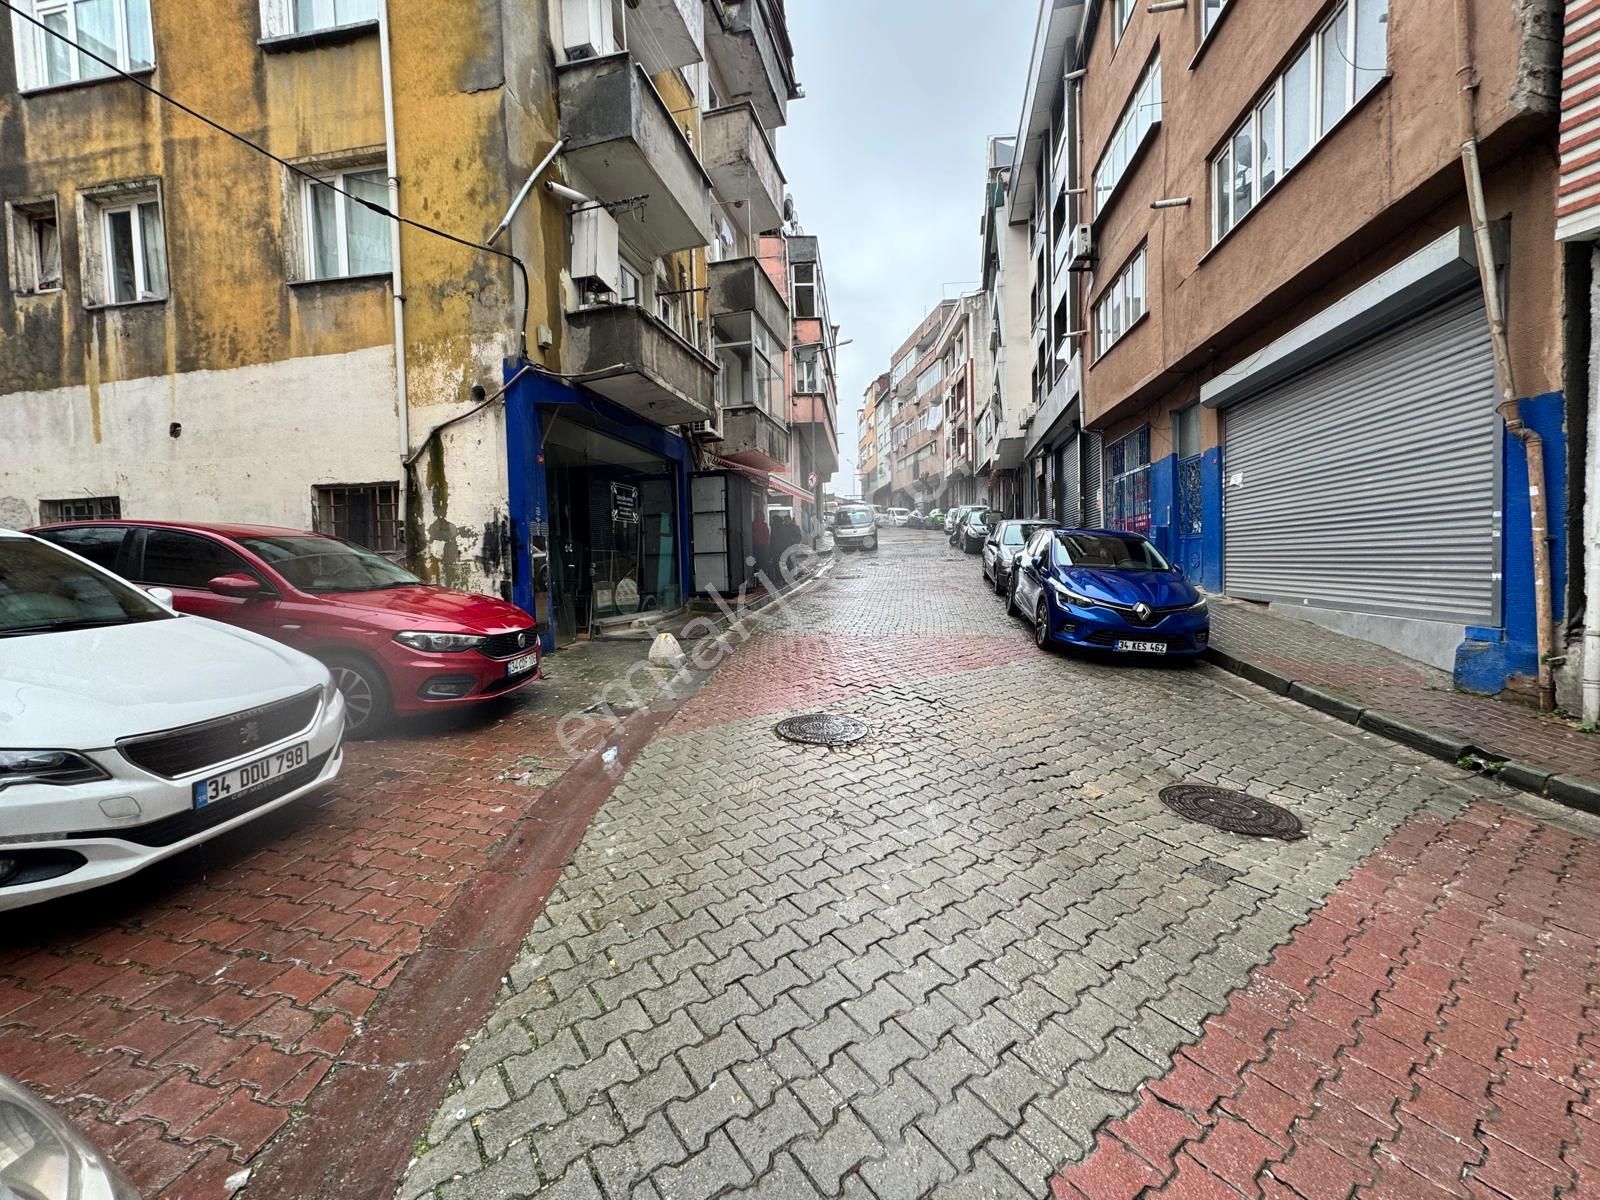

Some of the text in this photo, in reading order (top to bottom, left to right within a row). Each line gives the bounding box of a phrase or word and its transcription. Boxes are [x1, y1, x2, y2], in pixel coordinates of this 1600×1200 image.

[1119, 641, 1165, 652] 34 KES 462
[511, 659, 518, 672] 34
[208, 747, 303, 800] 34 DDU 798
